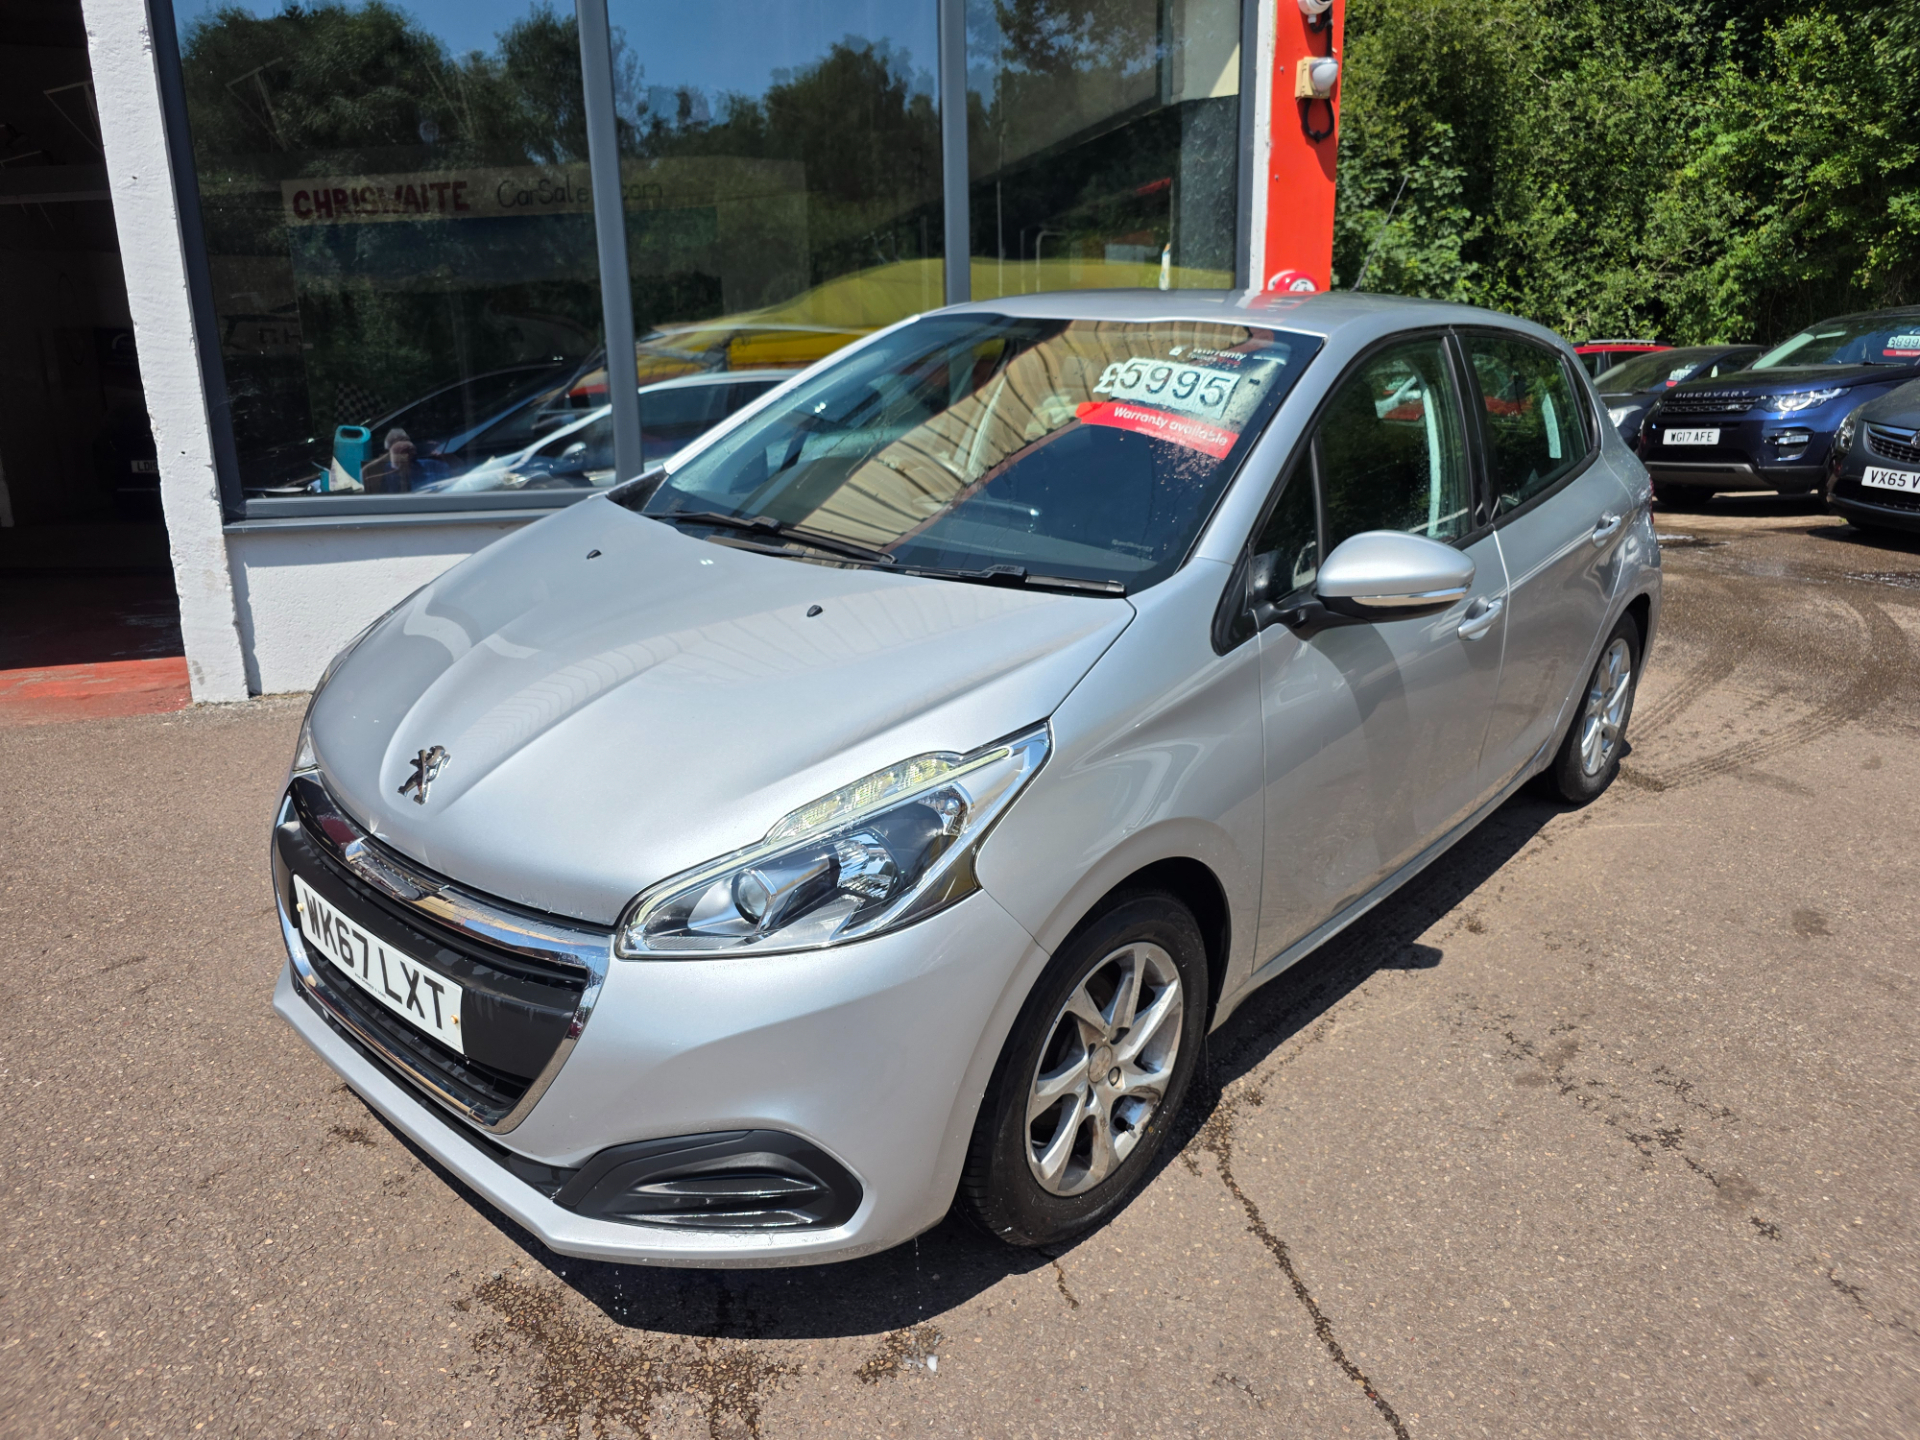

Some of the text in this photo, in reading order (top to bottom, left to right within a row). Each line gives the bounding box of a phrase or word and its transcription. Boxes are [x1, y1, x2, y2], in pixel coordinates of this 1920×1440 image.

[1887, 336, 1920, 348] £899
[1092, 361, 1232, 408] £5995
[1675, 390, 1750, 398] DISCOVERY
[1113, 406, 1168, 429] Warranty
[1168, 421, 1229, 447] available
[1670, 431, 1714, 442] WG17 AFE
[1870, 469, 1908, 488] VX65
[302, 887, 446, 1031] WK67 LXT
